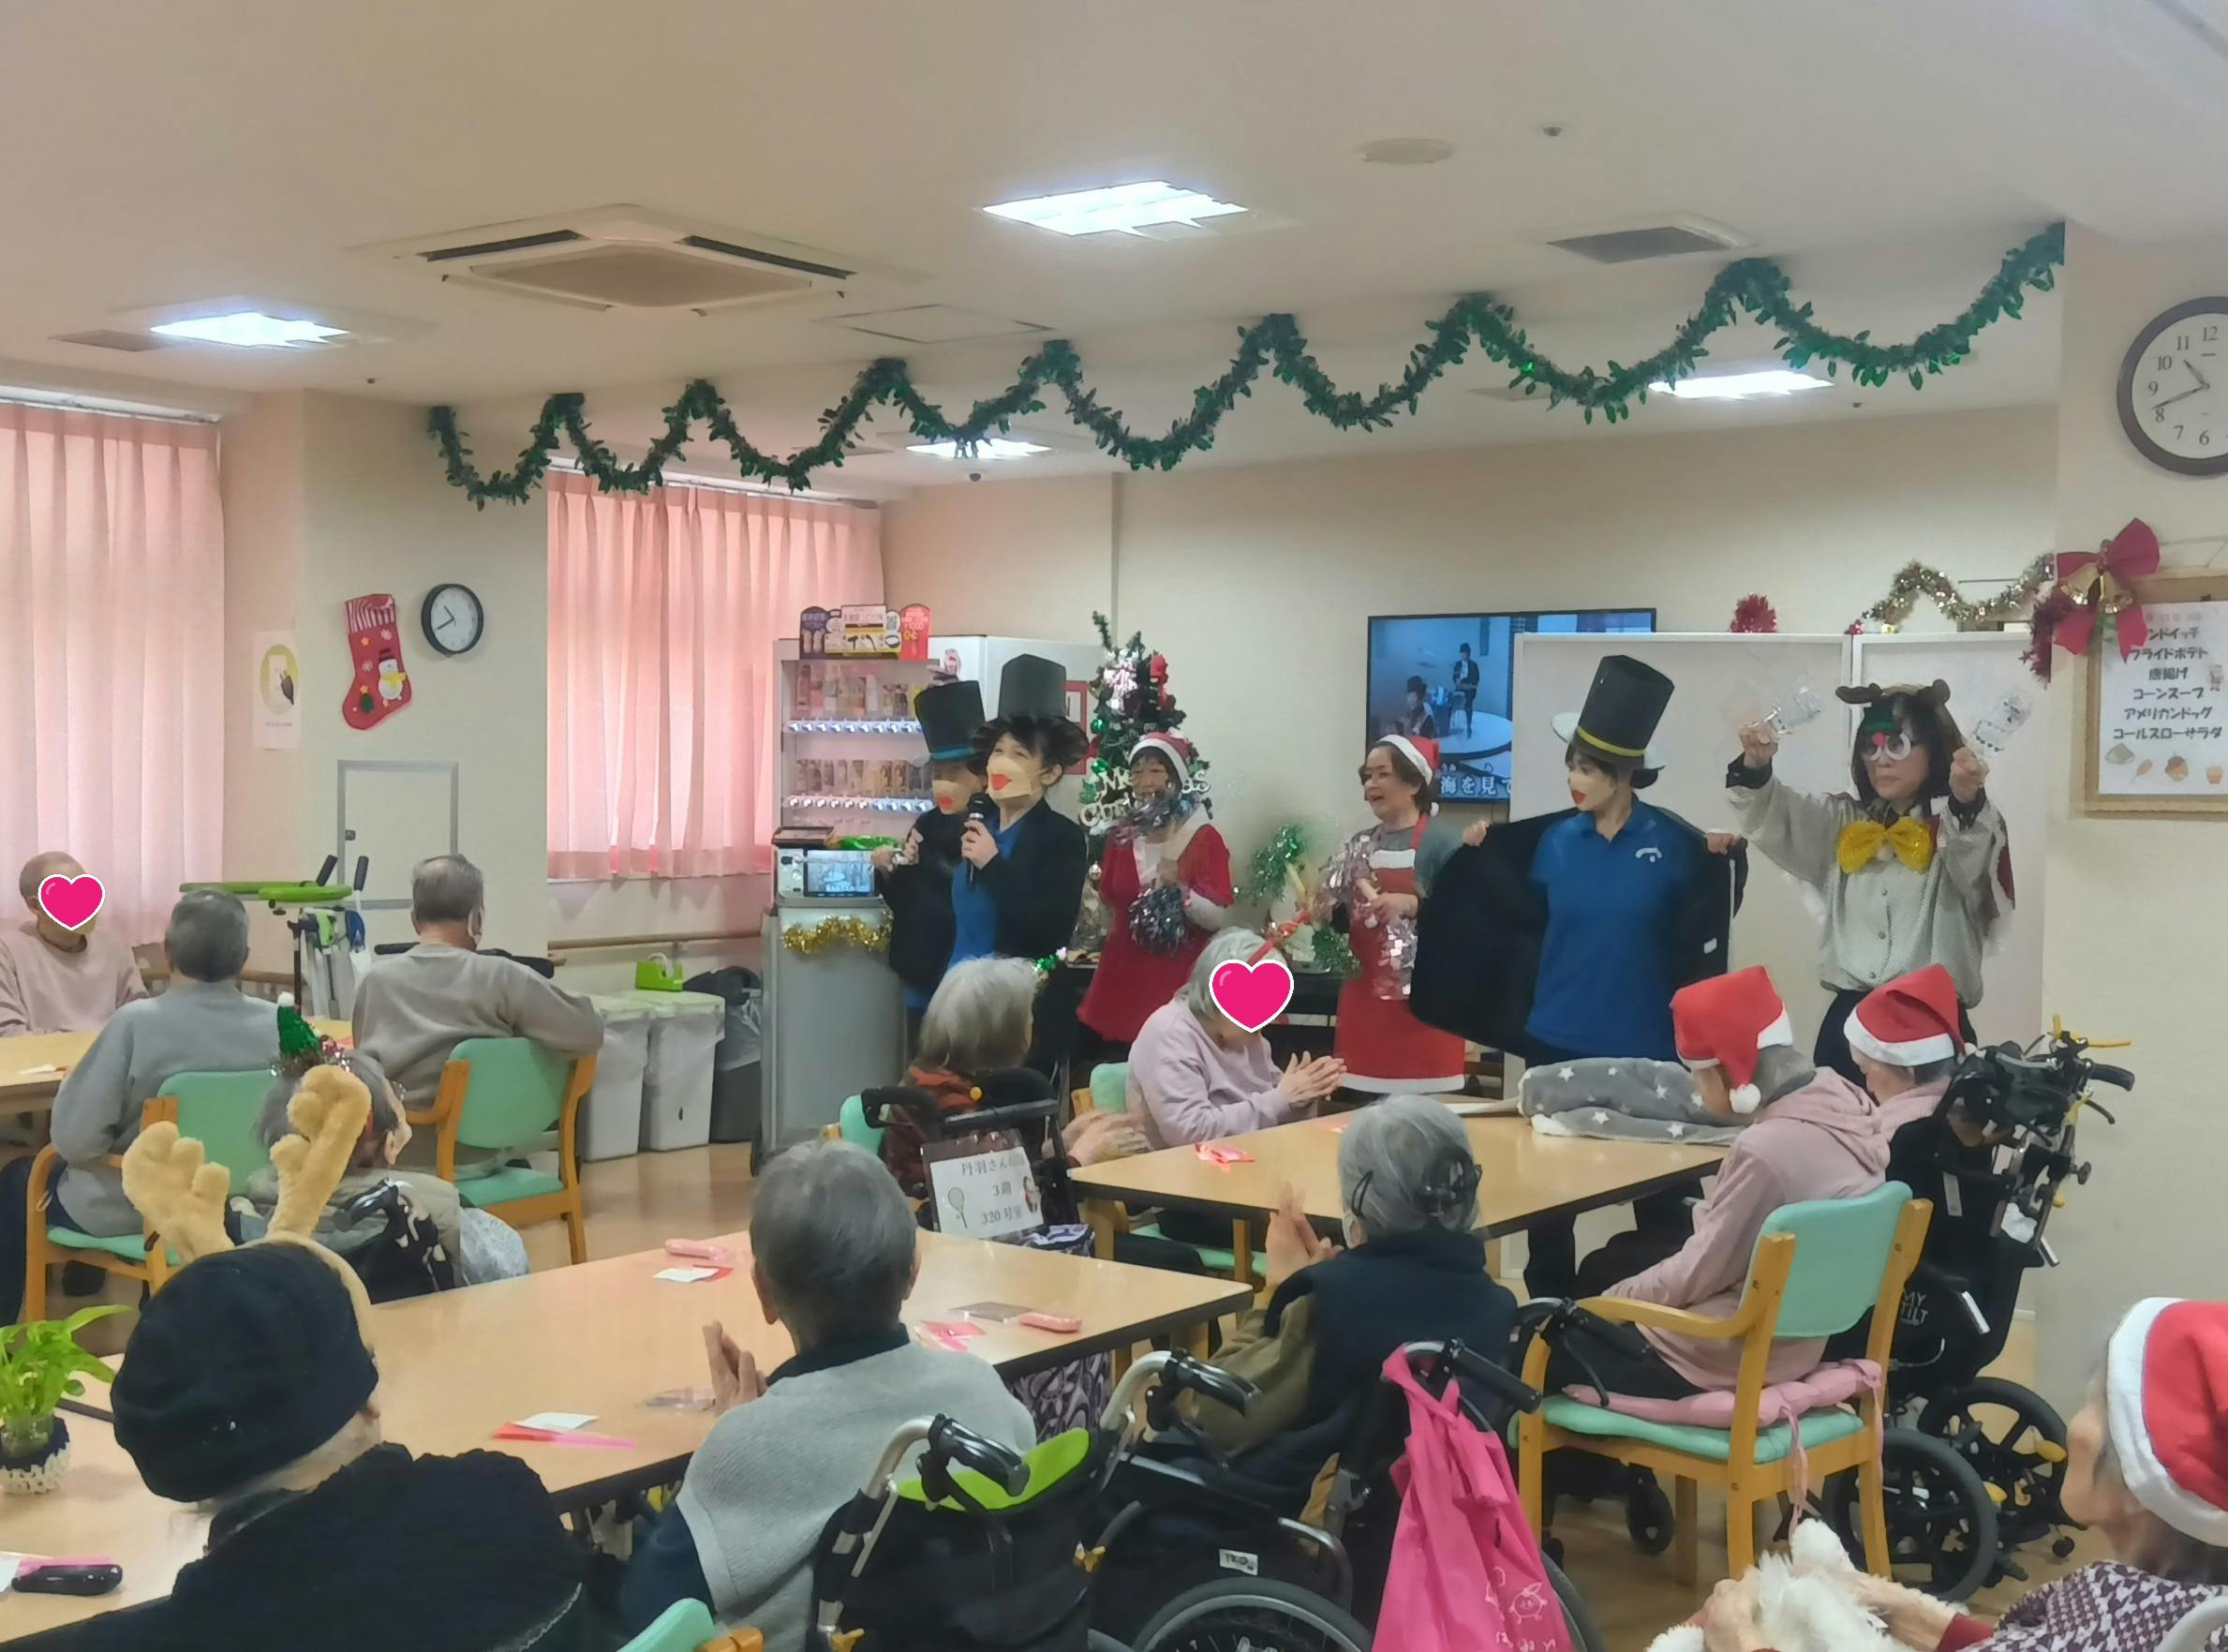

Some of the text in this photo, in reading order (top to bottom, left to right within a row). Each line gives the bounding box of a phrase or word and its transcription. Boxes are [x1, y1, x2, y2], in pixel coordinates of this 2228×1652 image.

[2203, 326, 2219, 341] 12
[2176, 335, 2190, 350] 11
[2157, 355, 2173, 371] 10
[2147, 380, 2159, 396] 9
[2155, 407, 2165, 423] 8
[2174, 424, 2184, 439] 7
[2199, 429, 2210, 445] 6
[2148, 627, 2199, 640] ンドイッチ
